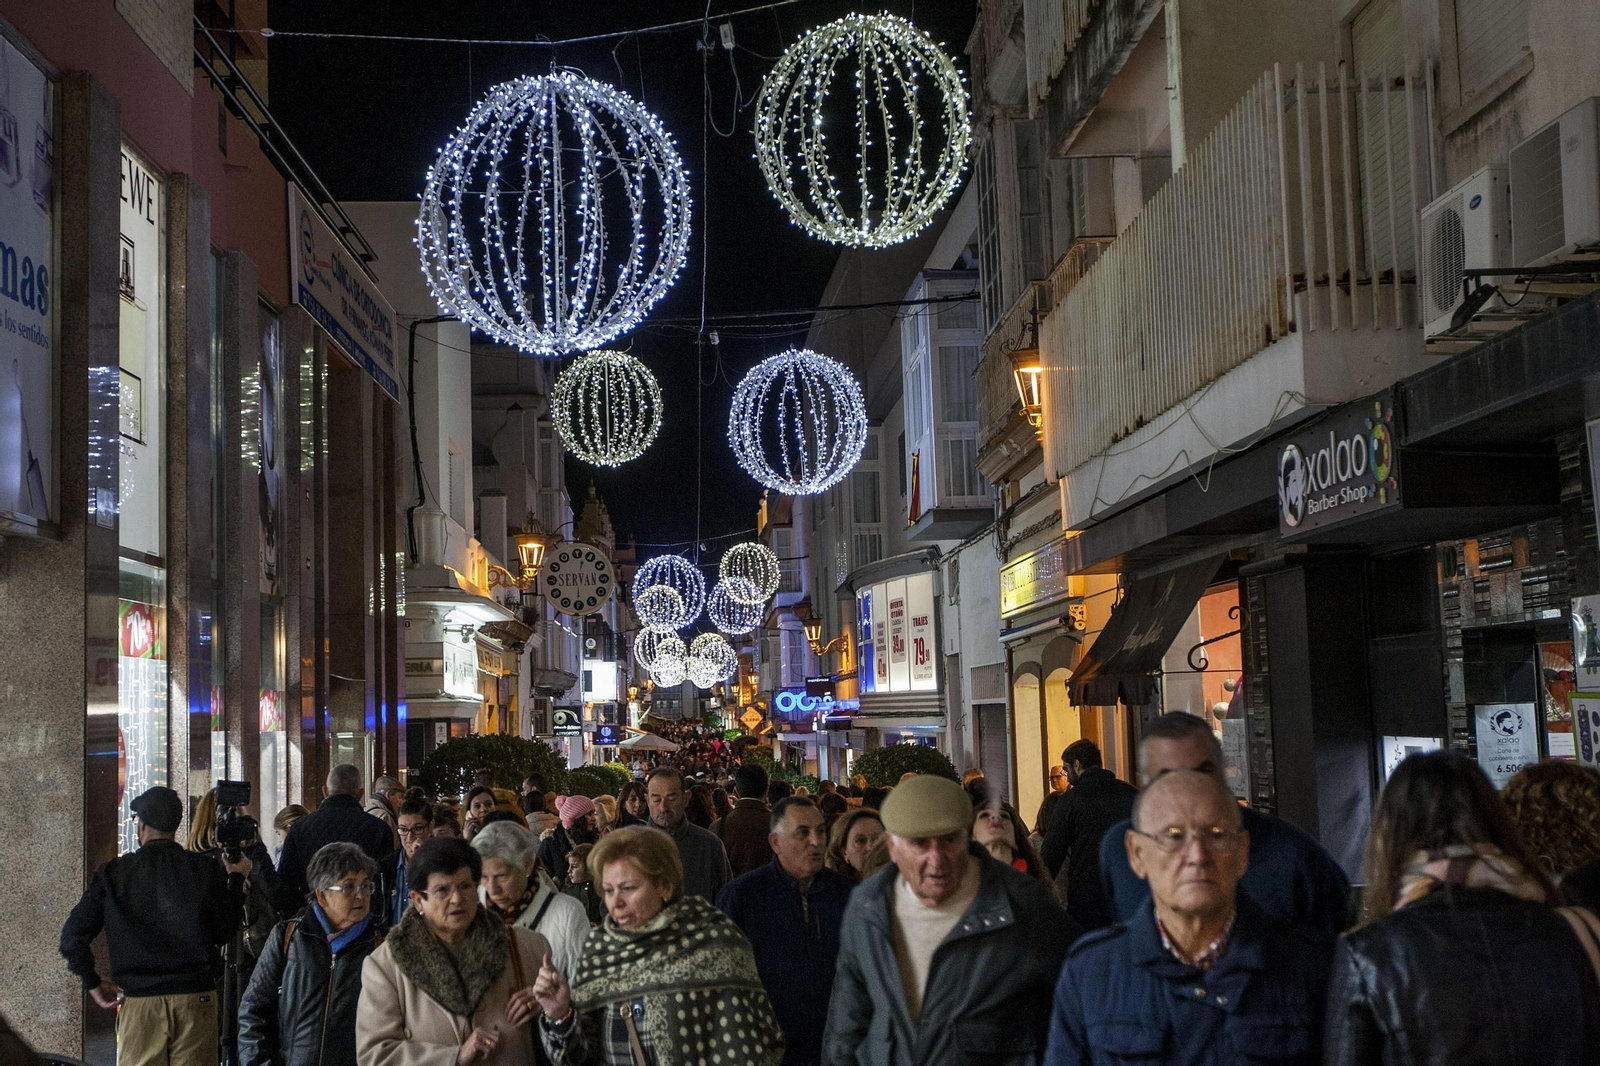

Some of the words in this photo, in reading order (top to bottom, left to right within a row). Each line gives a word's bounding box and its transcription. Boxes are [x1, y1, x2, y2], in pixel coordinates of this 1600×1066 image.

[5, 309, 16, 334] los
[18, 322, 49, 350] sentidos
[1308, 494, 1339, 514] Barber
[1340, 485, 1367, 504] Shop
[558, 573, 597, 587] SERVAN
[912, 616, 929, 627] TRAJES
